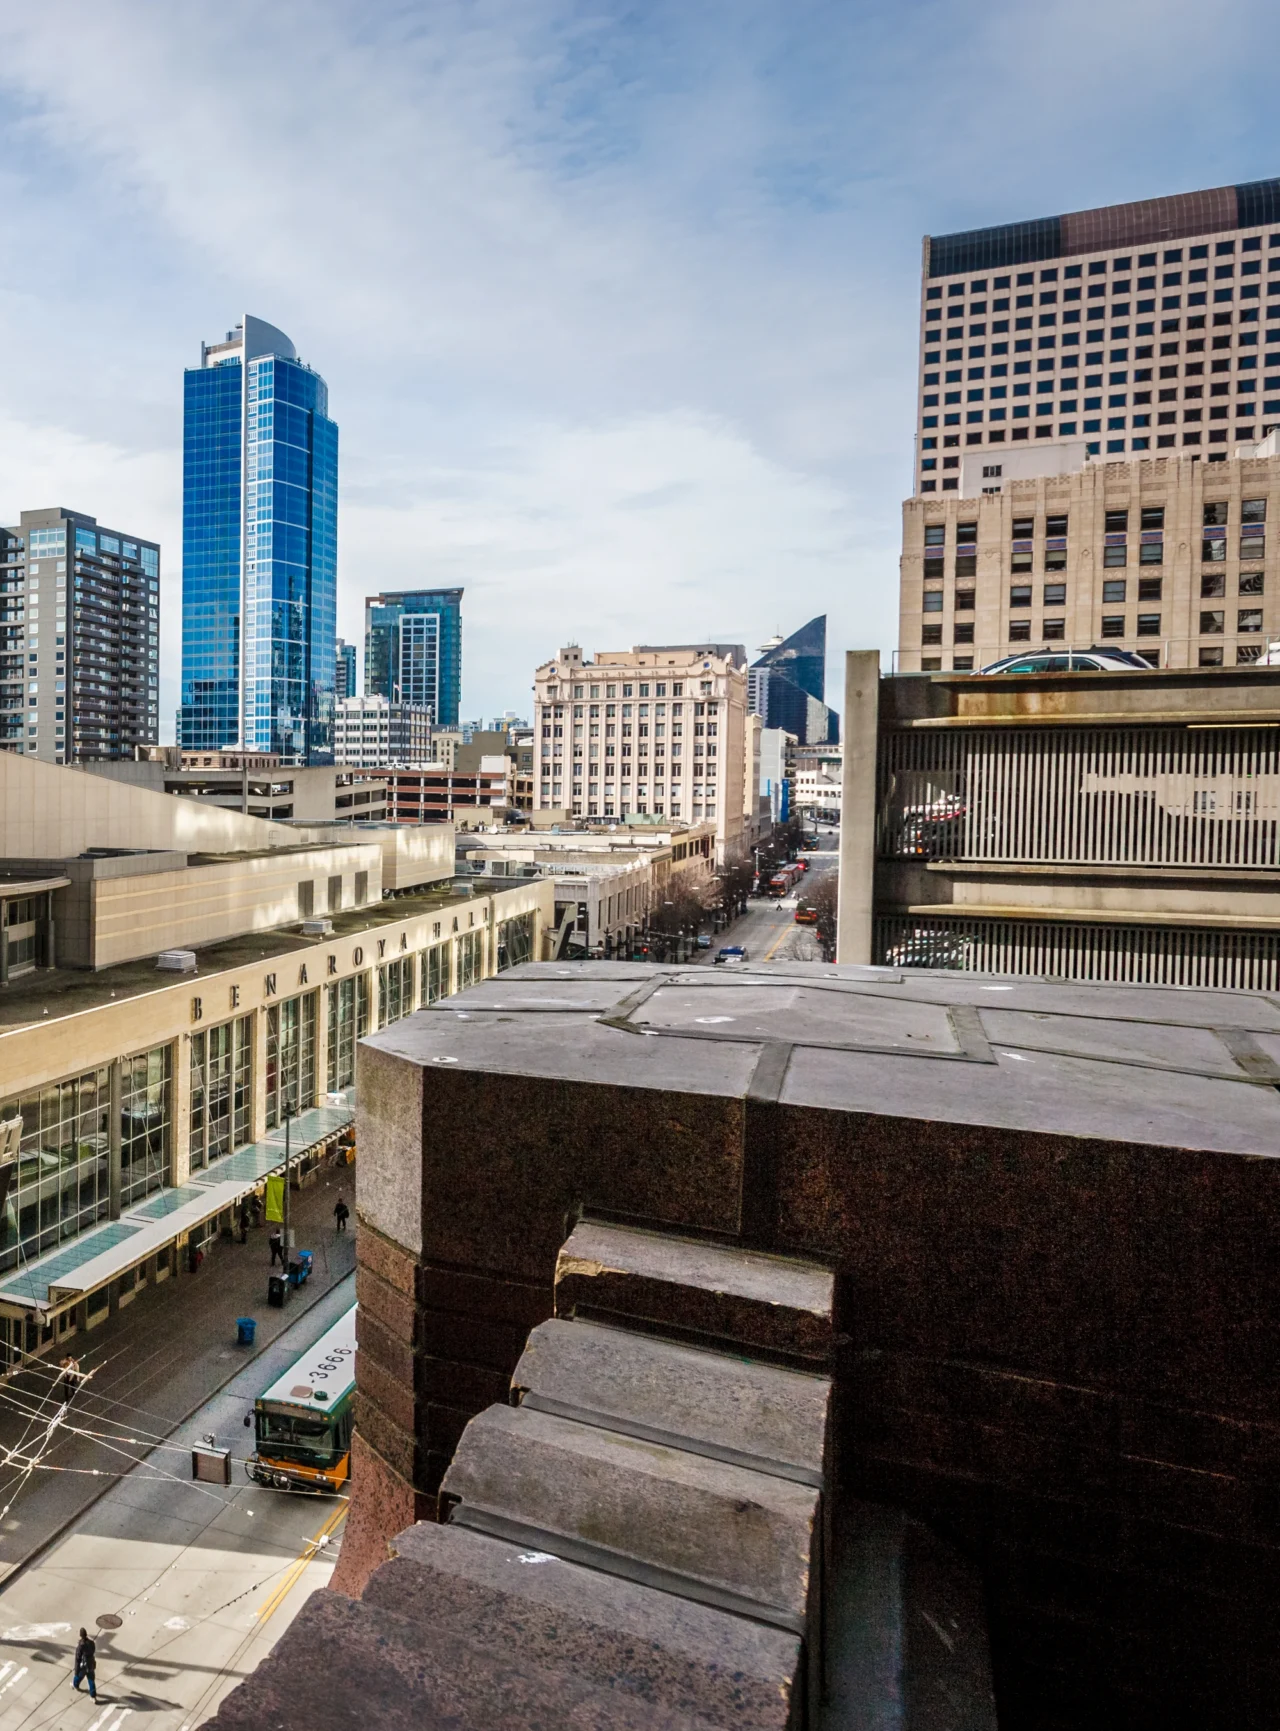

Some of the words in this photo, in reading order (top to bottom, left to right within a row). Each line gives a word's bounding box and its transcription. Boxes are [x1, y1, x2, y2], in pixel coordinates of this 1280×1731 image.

[193, 932, 407, 1021] BENAROYA
[433, 906, 489, 940] HALL
[309, 1347, 352, 1379] 3666
